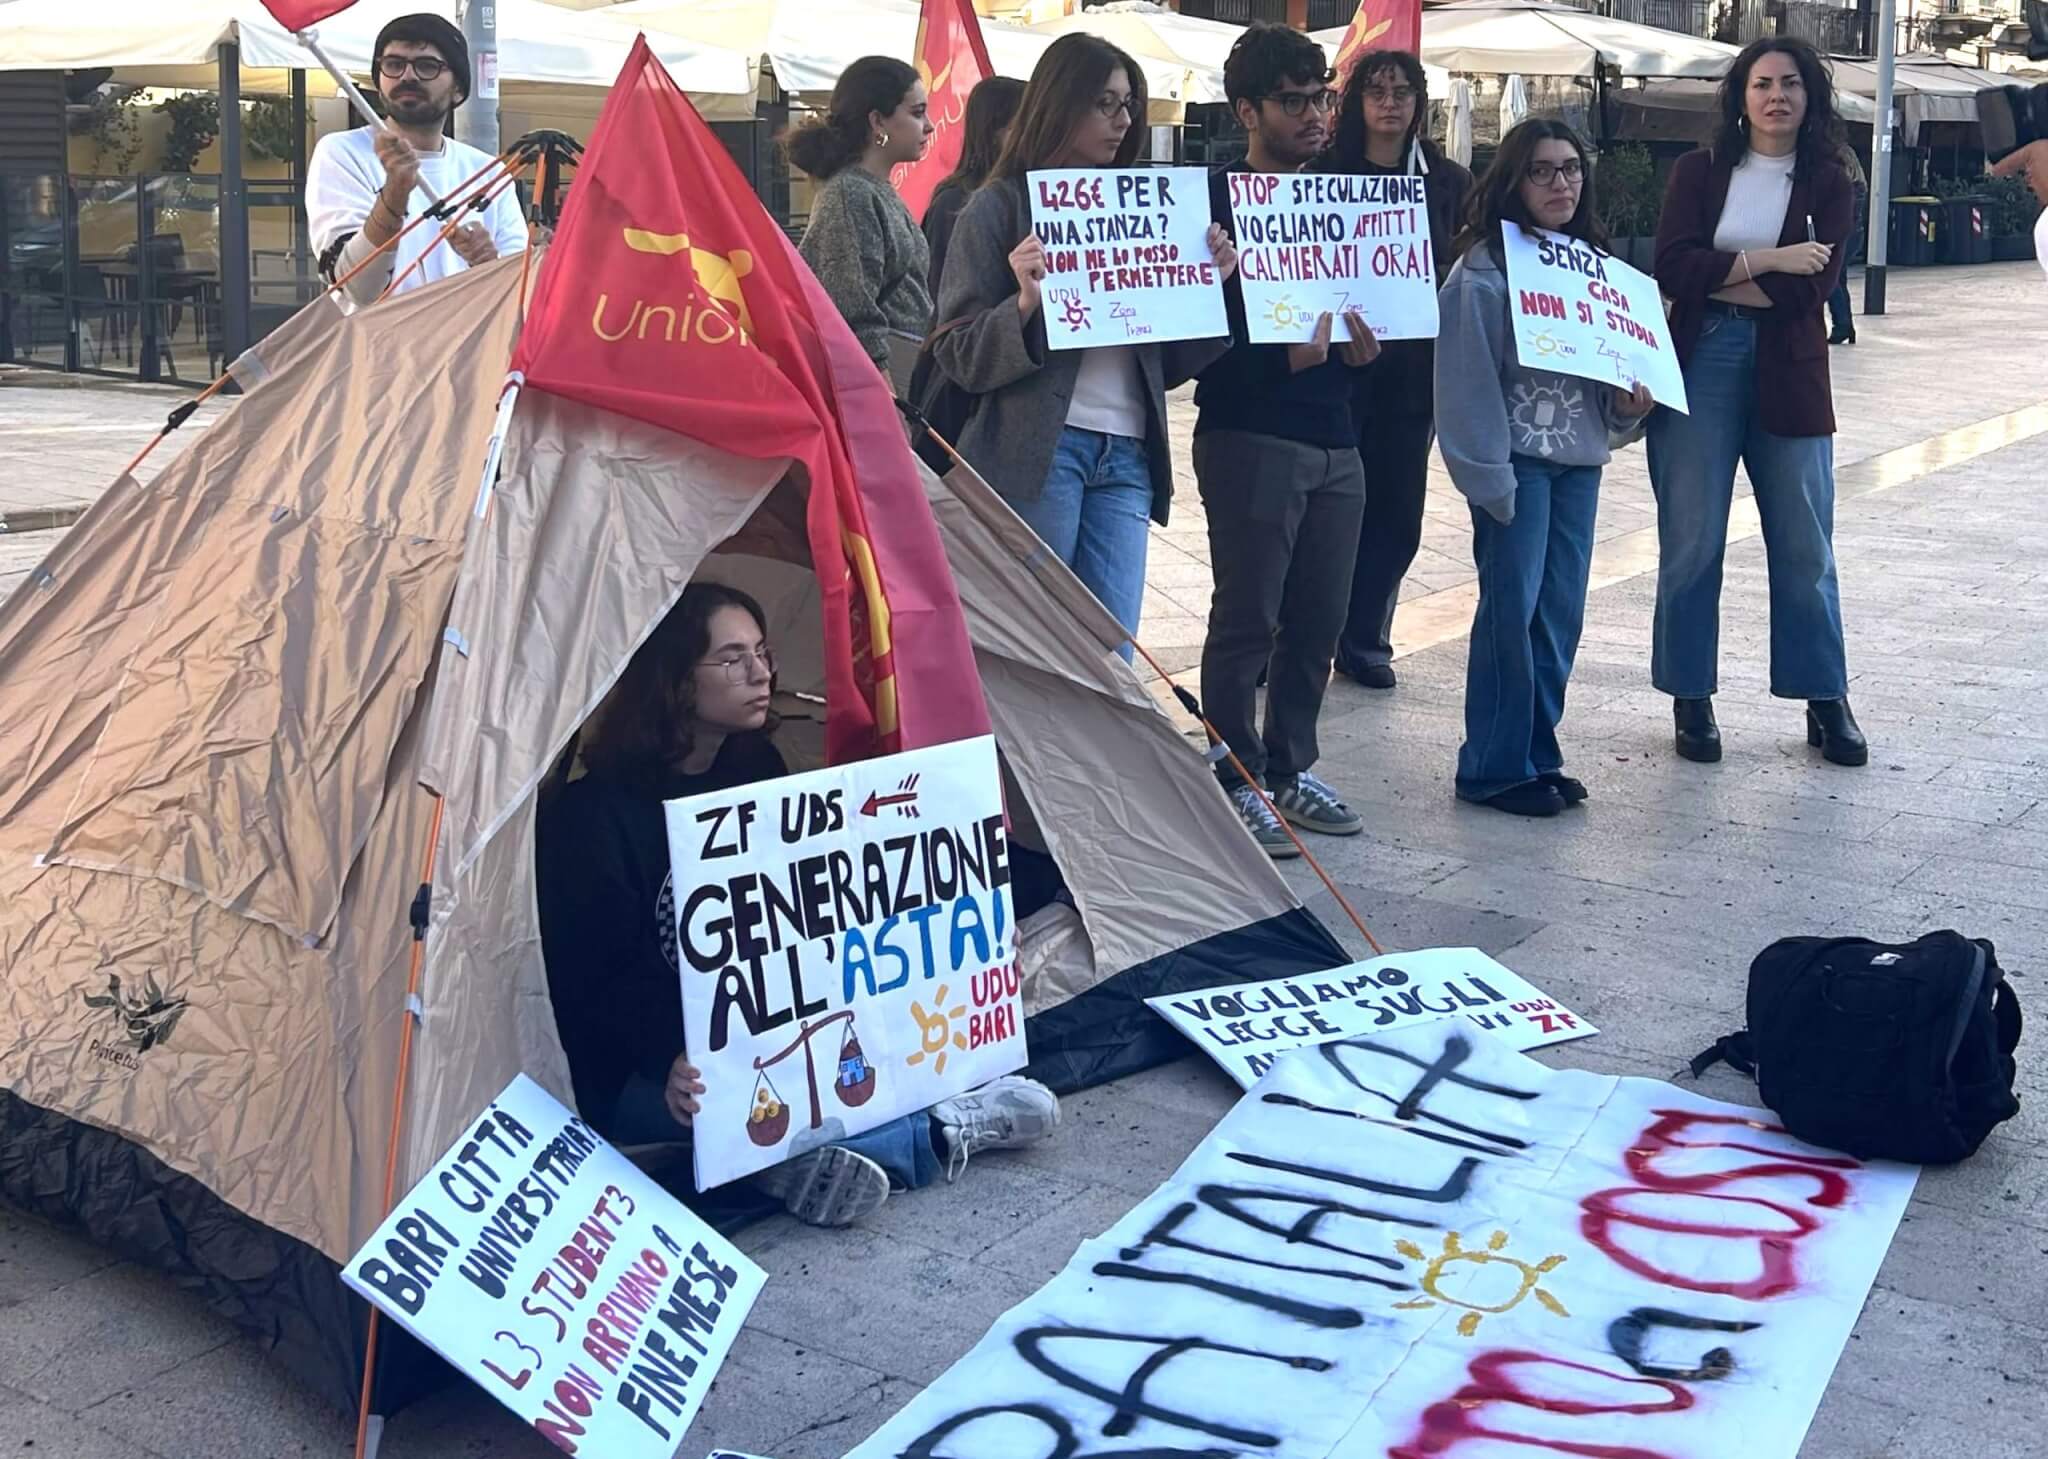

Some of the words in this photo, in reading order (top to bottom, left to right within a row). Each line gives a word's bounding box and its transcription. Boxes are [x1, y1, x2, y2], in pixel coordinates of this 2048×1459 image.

[1038, 177, 1105, 212] 426€
[1116, 175, 1176, 208] PER
[1230, 174, 1279, 208] STOP
[1292, 176, 1425, 205] SPECULAZIONE
[1035, 220, 1082, 245] UNA
[1236, 212, 1345, 243] VOGLIAMO
[1352, 208, 1416, 239] AFFITTI
[1045, 251, 1078, 274] NON
[1085, 249, 1107, 270] ME
[1113, 247, 1129, 266] LO
[1135, 244, 1179, 265] POSSO
[1088, 262, 1214, 293] PERMETTERE
[1240, 244, 1359, 281] CALMIERATI
[1371, 240, 1431, 284] ORA!
[1538, 240, 1608, 282] SENZA
[1048, 288, 1079, 304] UDU
[1588, 281, 1630, 312] CASA
[1519, 290, 1566, 320] NON
[1576, 301, 1593, 325] SI
[1606, 310, 1659, 351] STUDIA
[696, 801, 756, 860] ZF
[679, 814, 1010, 973] GENERAZIONE
[971, 962, 1019, 1007] UDU
[970, 1003, 1015, 1050] BARI
[1204, 1010, 1342, 1046] LEGGE
[1527, 1013, 1577, 1034] ZF
[1092, 1035, 1542, 1330] ITALIA
[358, 1207, 460, 1316] BARI
[657, 1242, 738, 1356] MESE
[534, 1363, 604, 1454] NON
[582, 1248, 669, 1376] ARRIVANO
[652, 1224, 682, 1257] A
[617, 1329, 698, 1442] FINE
